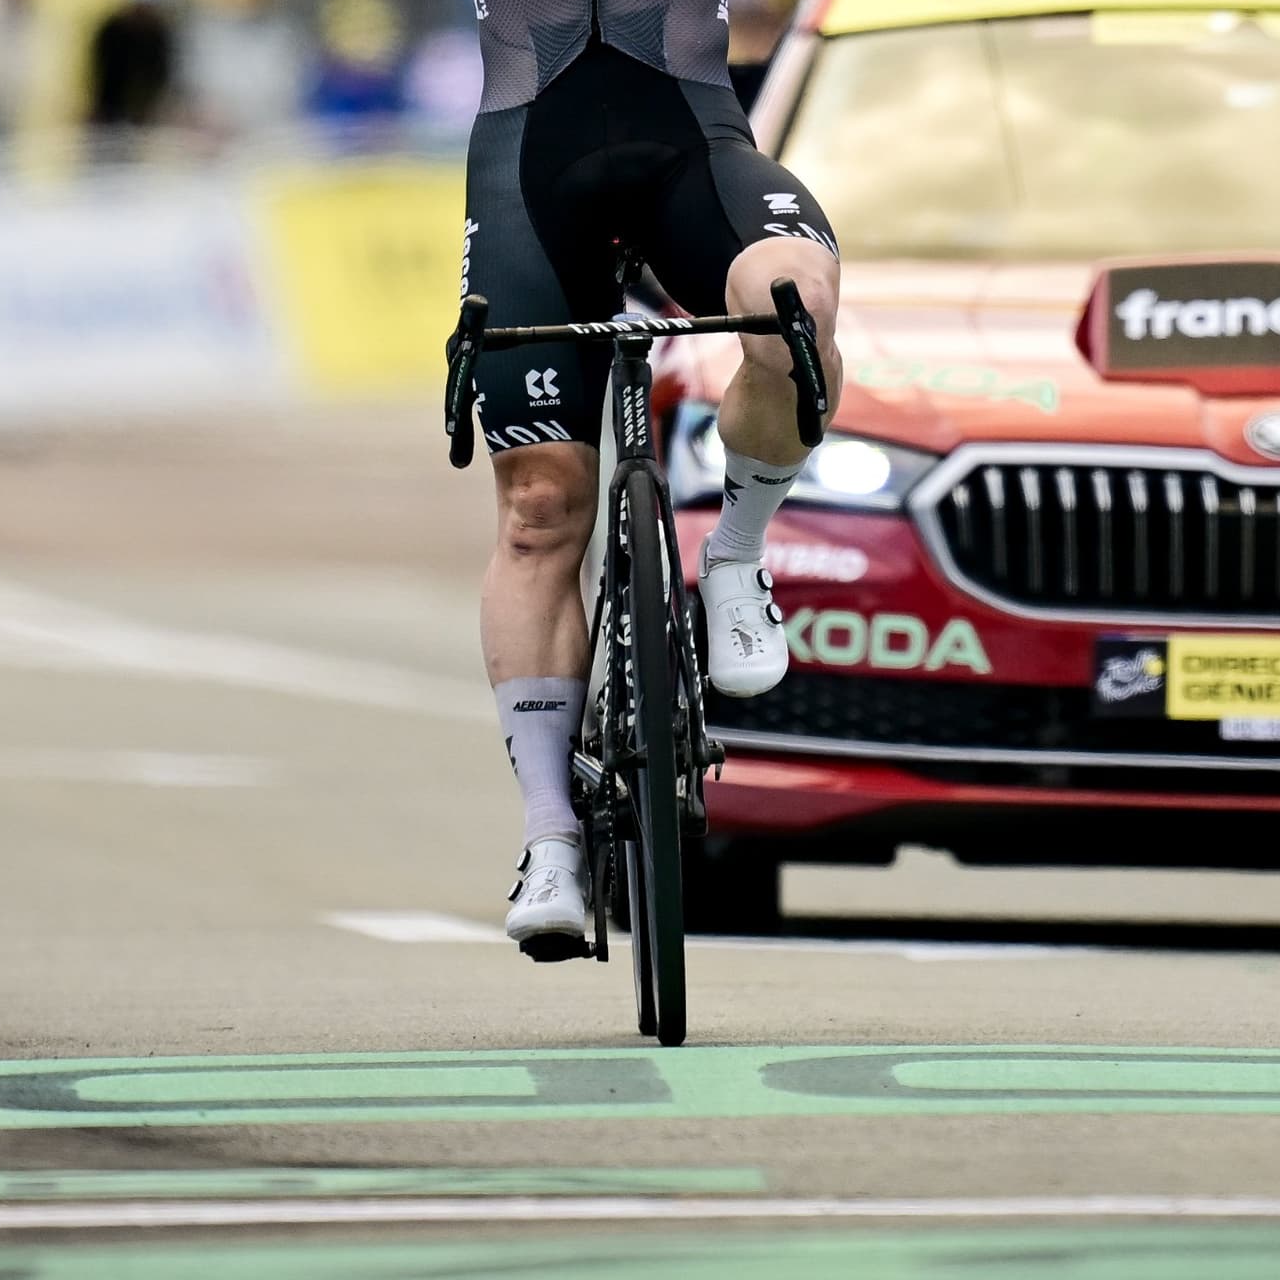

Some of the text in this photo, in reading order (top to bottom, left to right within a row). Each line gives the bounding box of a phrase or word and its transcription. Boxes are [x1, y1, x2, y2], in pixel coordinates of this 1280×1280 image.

[568, 318, 693, 335] CANYON
[622, 385, 635, 448] CANYON
[634, 386, 648, 447] CANYON
[784, 607, 993, 675] KODA
